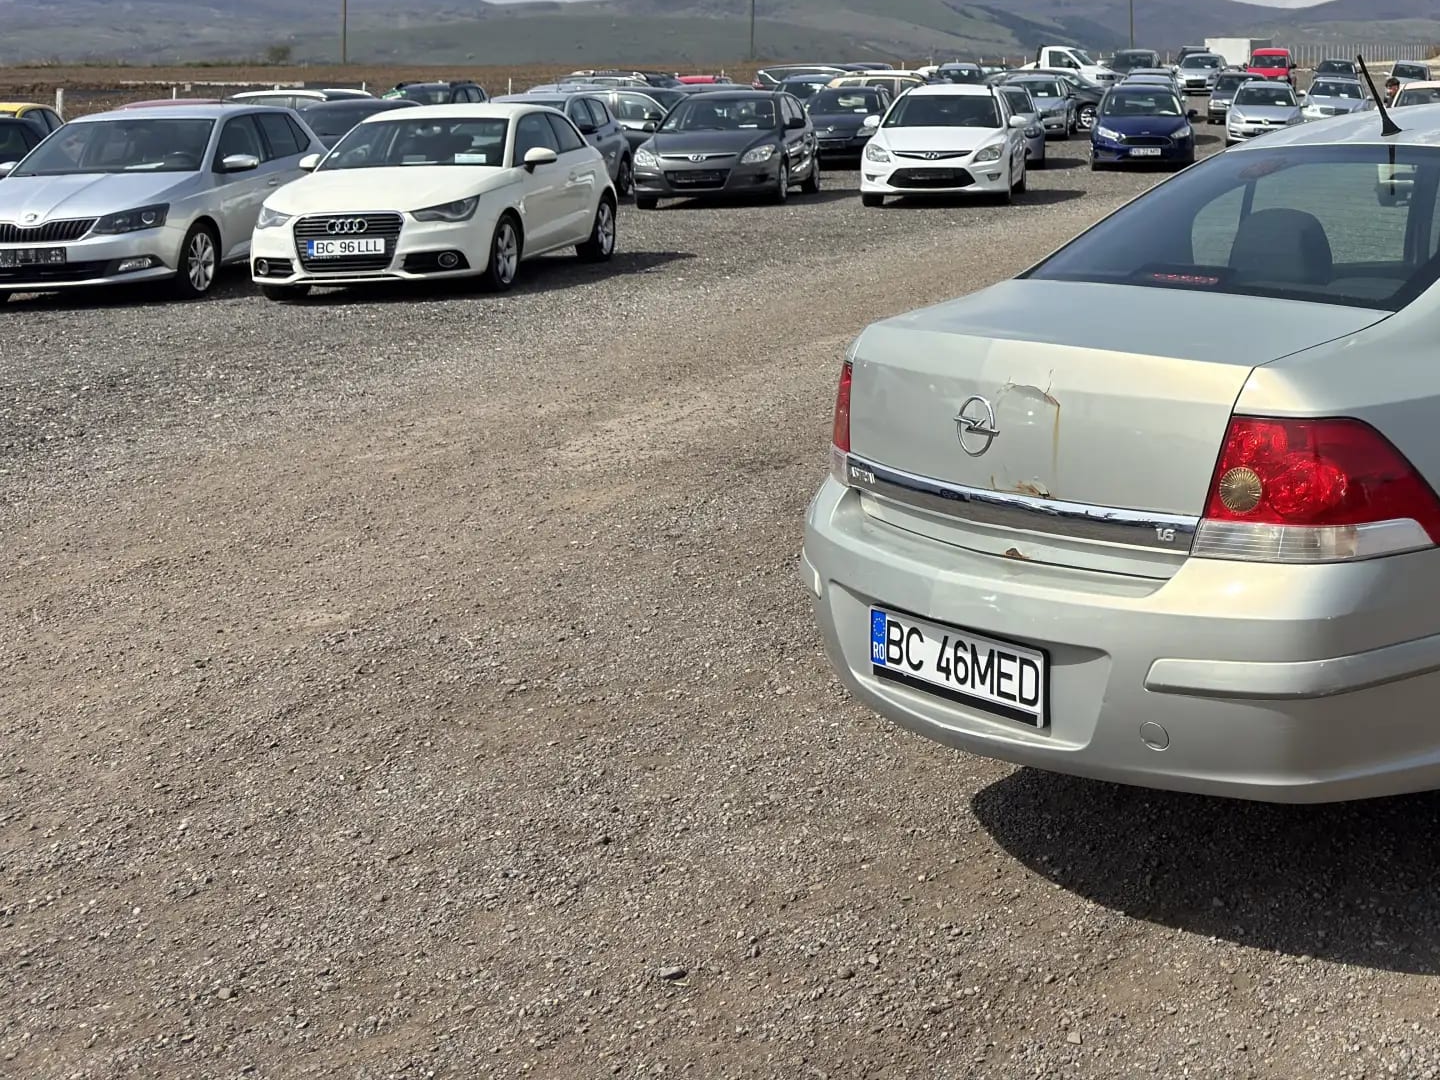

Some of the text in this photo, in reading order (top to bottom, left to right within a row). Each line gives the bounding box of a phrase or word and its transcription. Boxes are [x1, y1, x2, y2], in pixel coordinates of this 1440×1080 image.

[316, 240, 382, 254] BC 96 LLL
[873, 619, 1040, 708] RO BC 46MED
